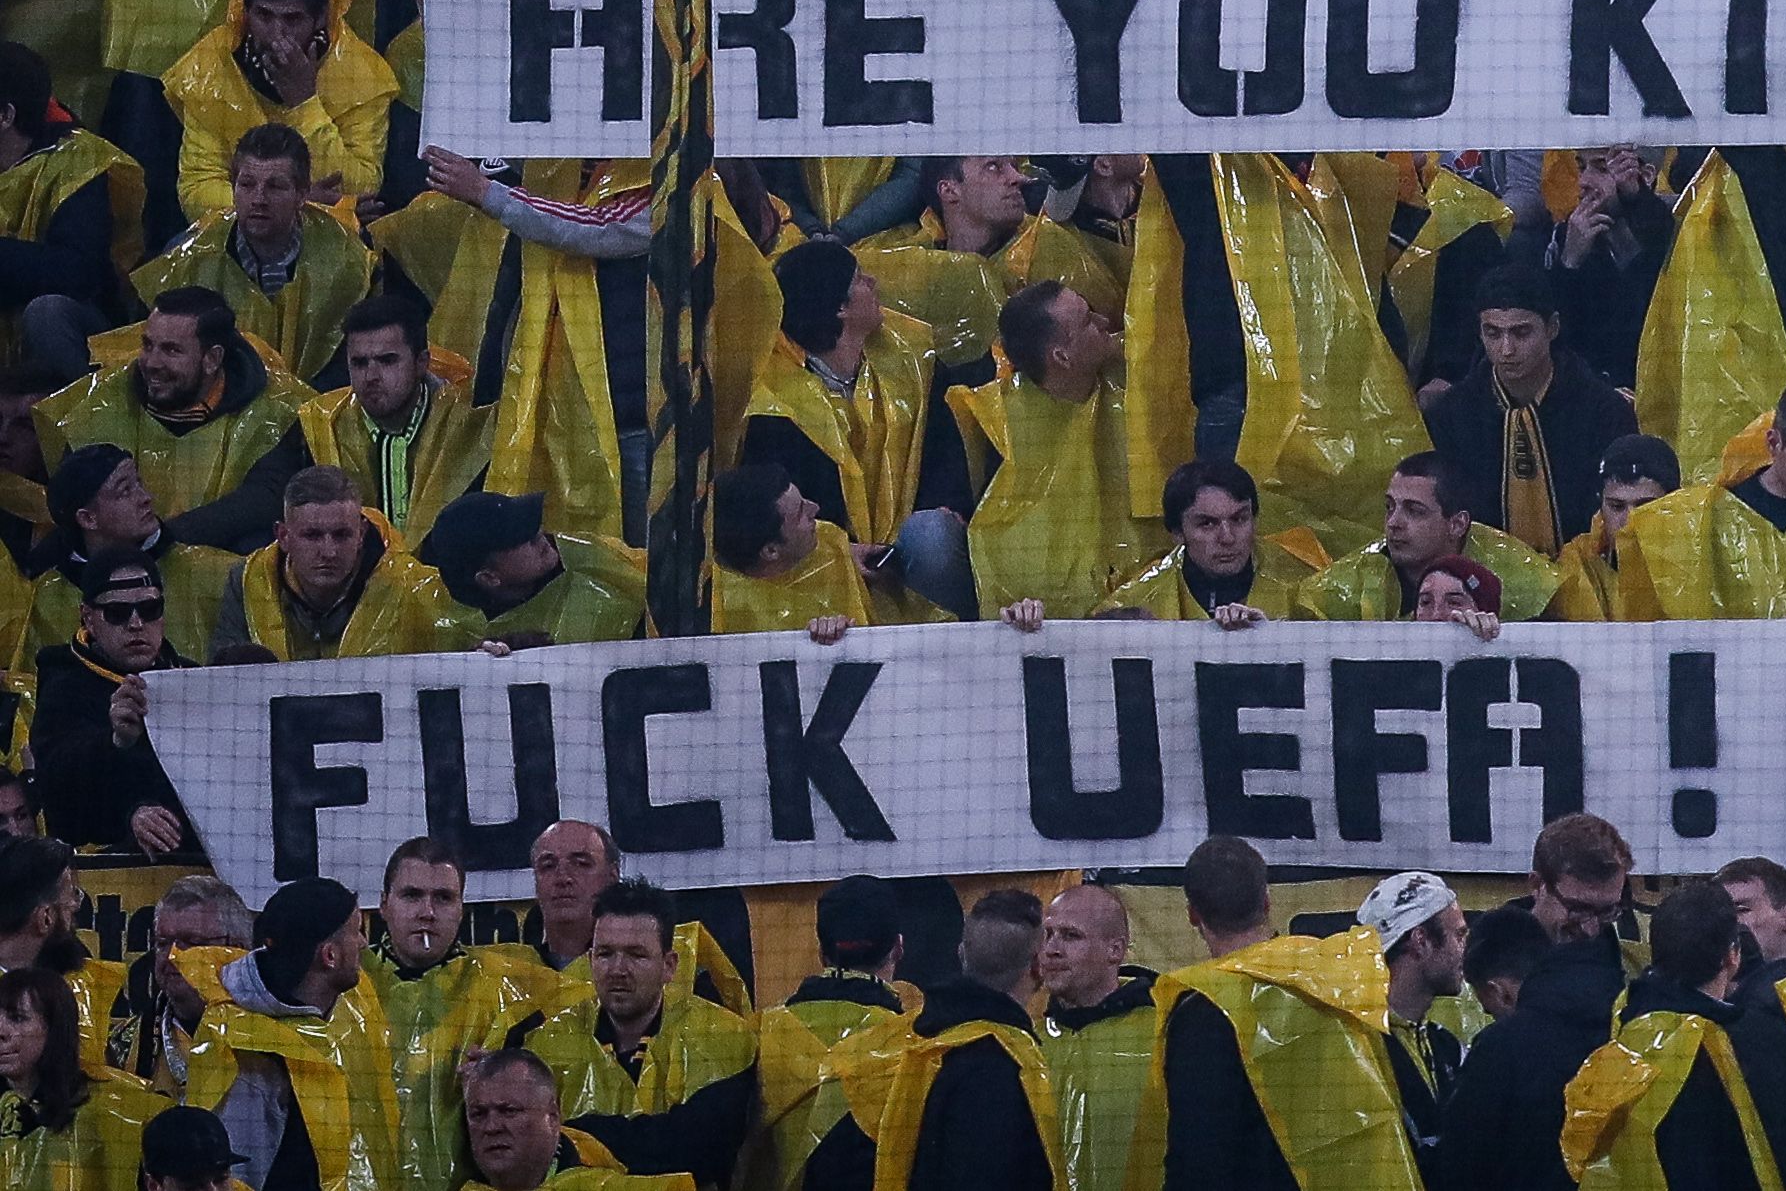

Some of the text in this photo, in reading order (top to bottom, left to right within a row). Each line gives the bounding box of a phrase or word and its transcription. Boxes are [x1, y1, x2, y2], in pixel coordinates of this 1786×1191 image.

[269, 651, 1717, 883] FUCK UEFA !
